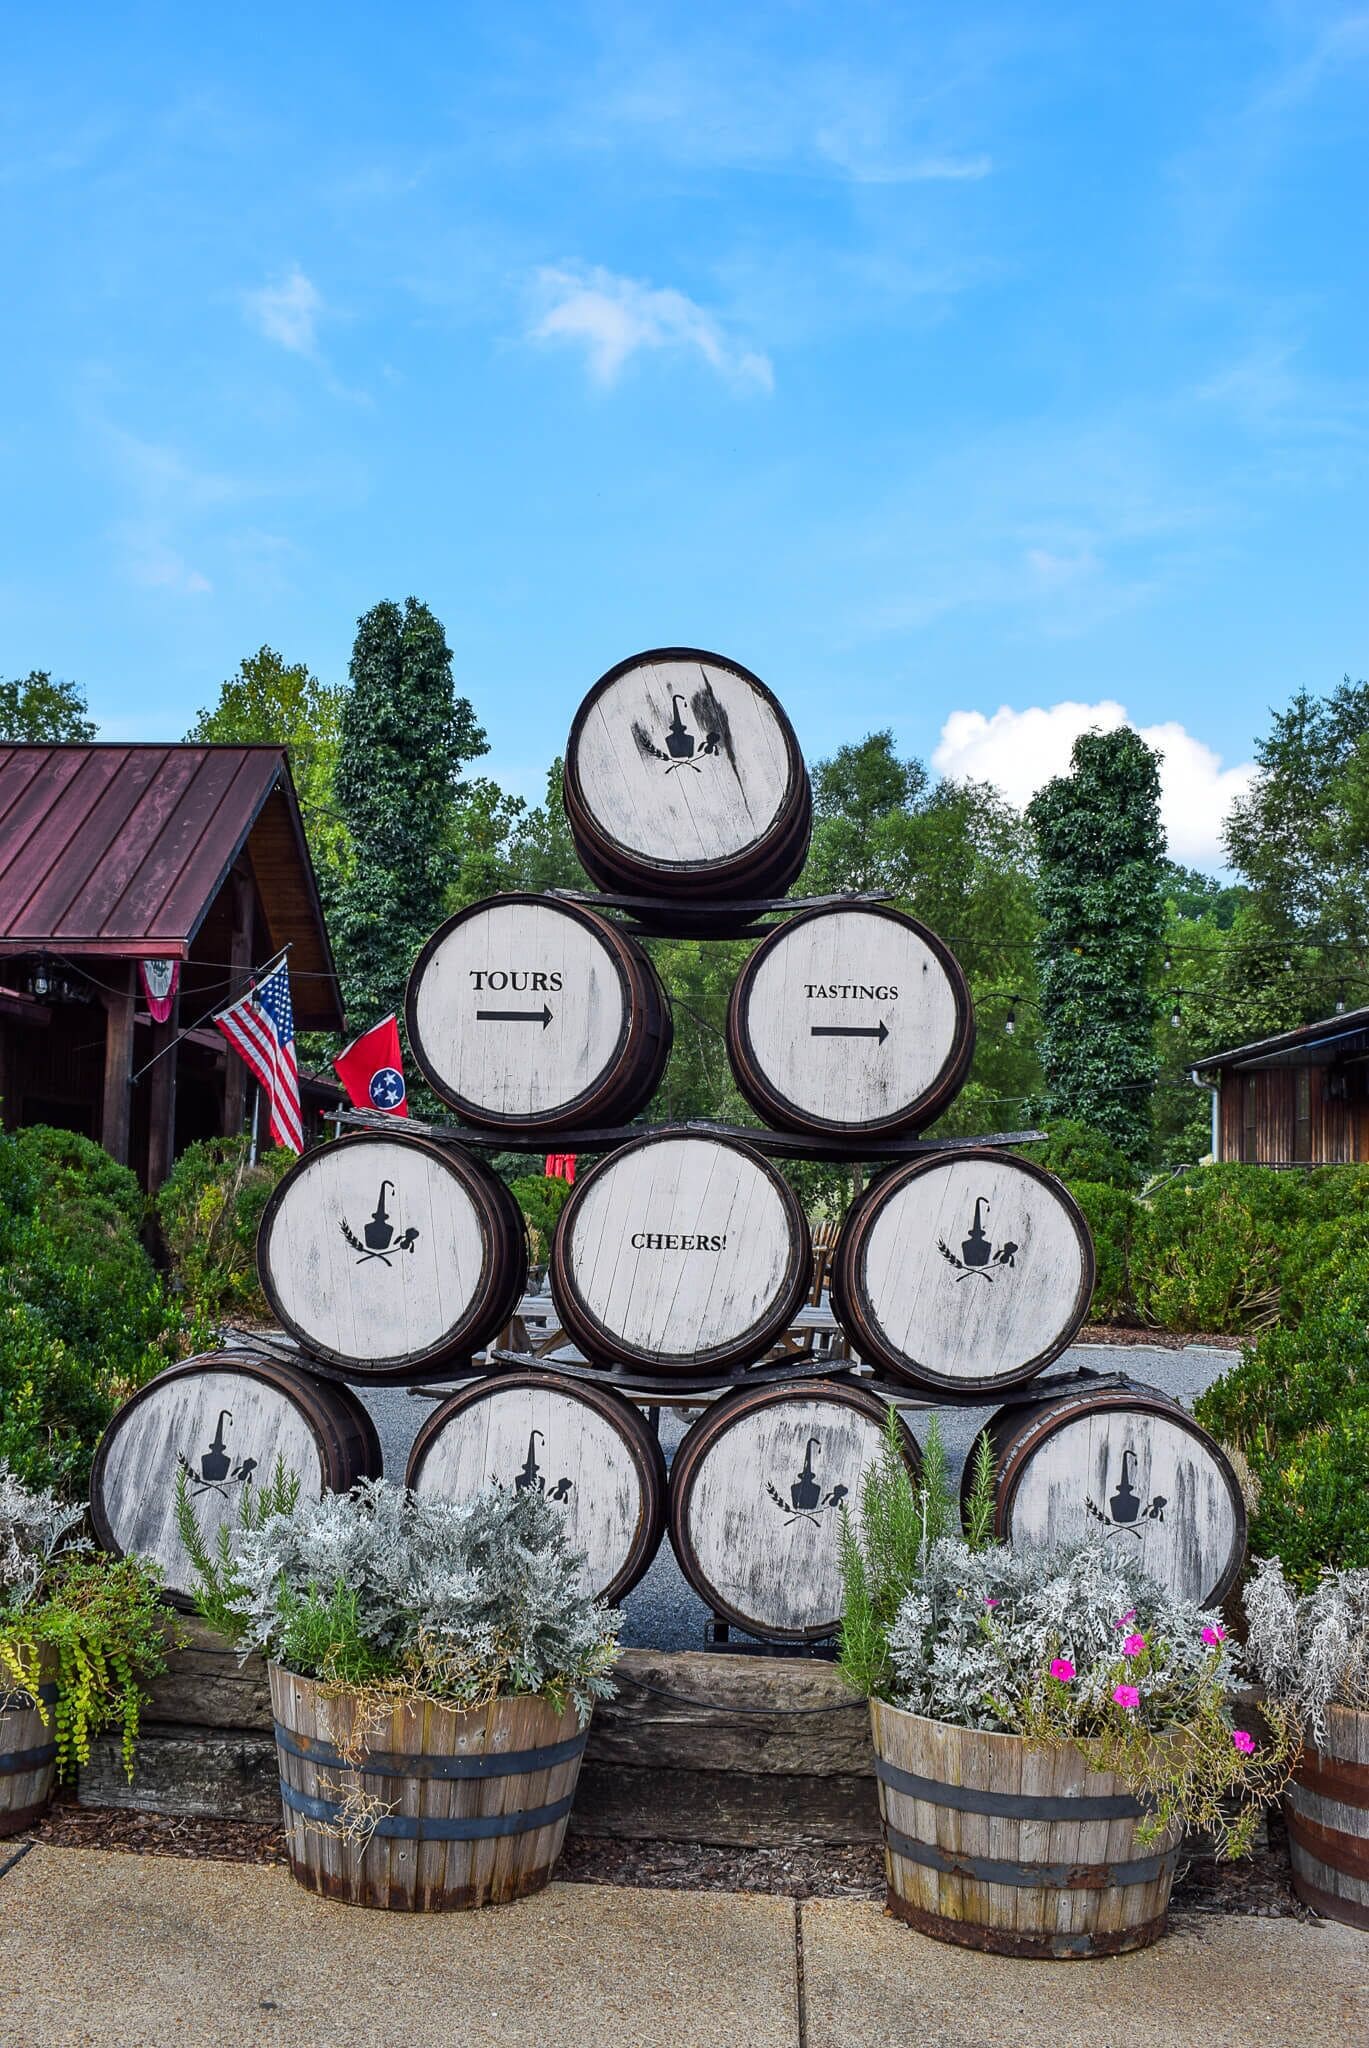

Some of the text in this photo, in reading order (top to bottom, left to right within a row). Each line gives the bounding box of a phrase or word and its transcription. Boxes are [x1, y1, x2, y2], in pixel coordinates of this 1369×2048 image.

[469, 970, 563, 992] TOURS
[804, 984, 899, 1000] TASTINGS
[631, 1233, 727, 1252] CHEERS!
